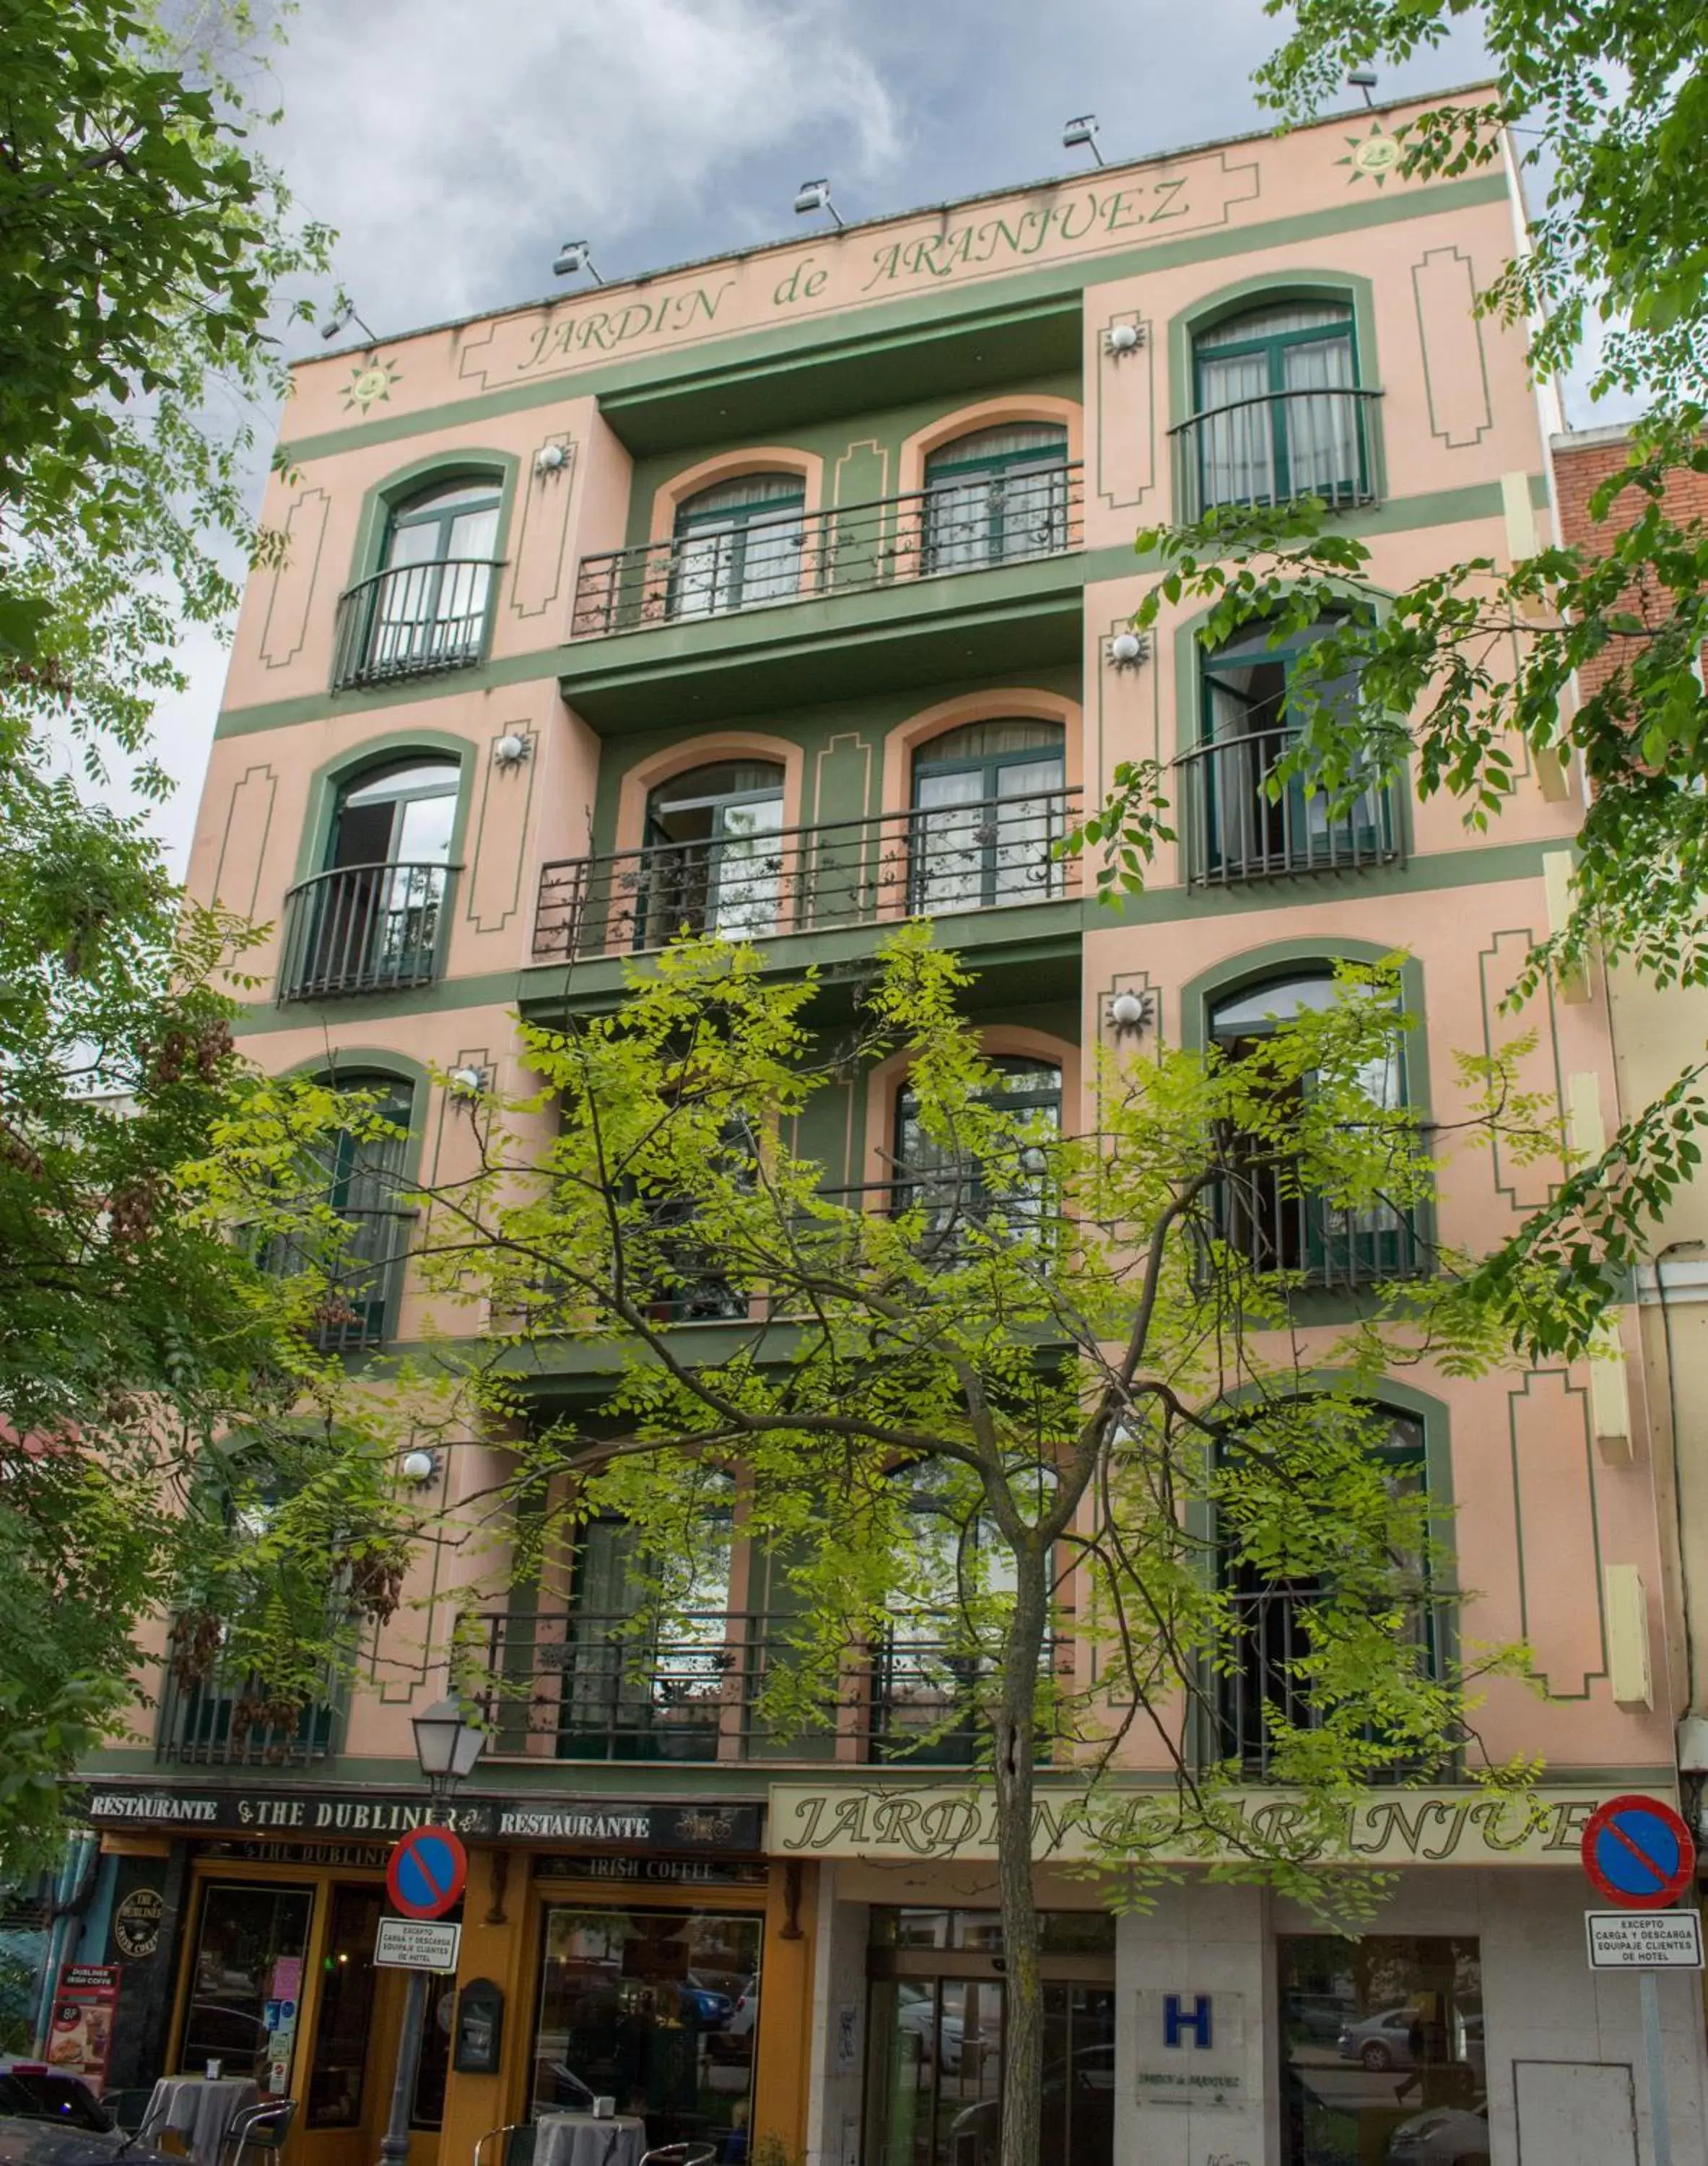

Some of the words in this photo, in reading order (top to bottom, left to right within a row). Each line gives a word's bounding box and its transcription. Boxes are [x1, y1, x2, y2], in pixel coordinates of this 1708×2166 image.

[517, 280, 737, 370] JARDIN
[772, 257, 829, 306] de
[861, 176, 1190, 292] ARANJUEZ
[90, 1796, 218, 1821] RESTAURANTE
[256, 1801, 306, 1827] THE
[497, 1812, 650, 1838] RESTAURANTE
[301, 1845, 389, 1866] DUBLINE
[589, 1858, 640, 1877] IRISH
[646, 1861, 715, 1879] COFFEE
[1621, 1919, 1664, 1928] EXCEPTO
[1595, 1931, 1628, 1940] CARGA
[1640, 1930, 1692, 1939] DESCARGA
[1598, 1941, 1642, 1950] EQUIPAJE
[1644, 1941, 1692, 1950] CLIENTES
[1622, 1952, 1634, 1961] DE
[1638, 1952, 1669, 1961] HOTEL
[1163, 1994, 1213, 2049] H
